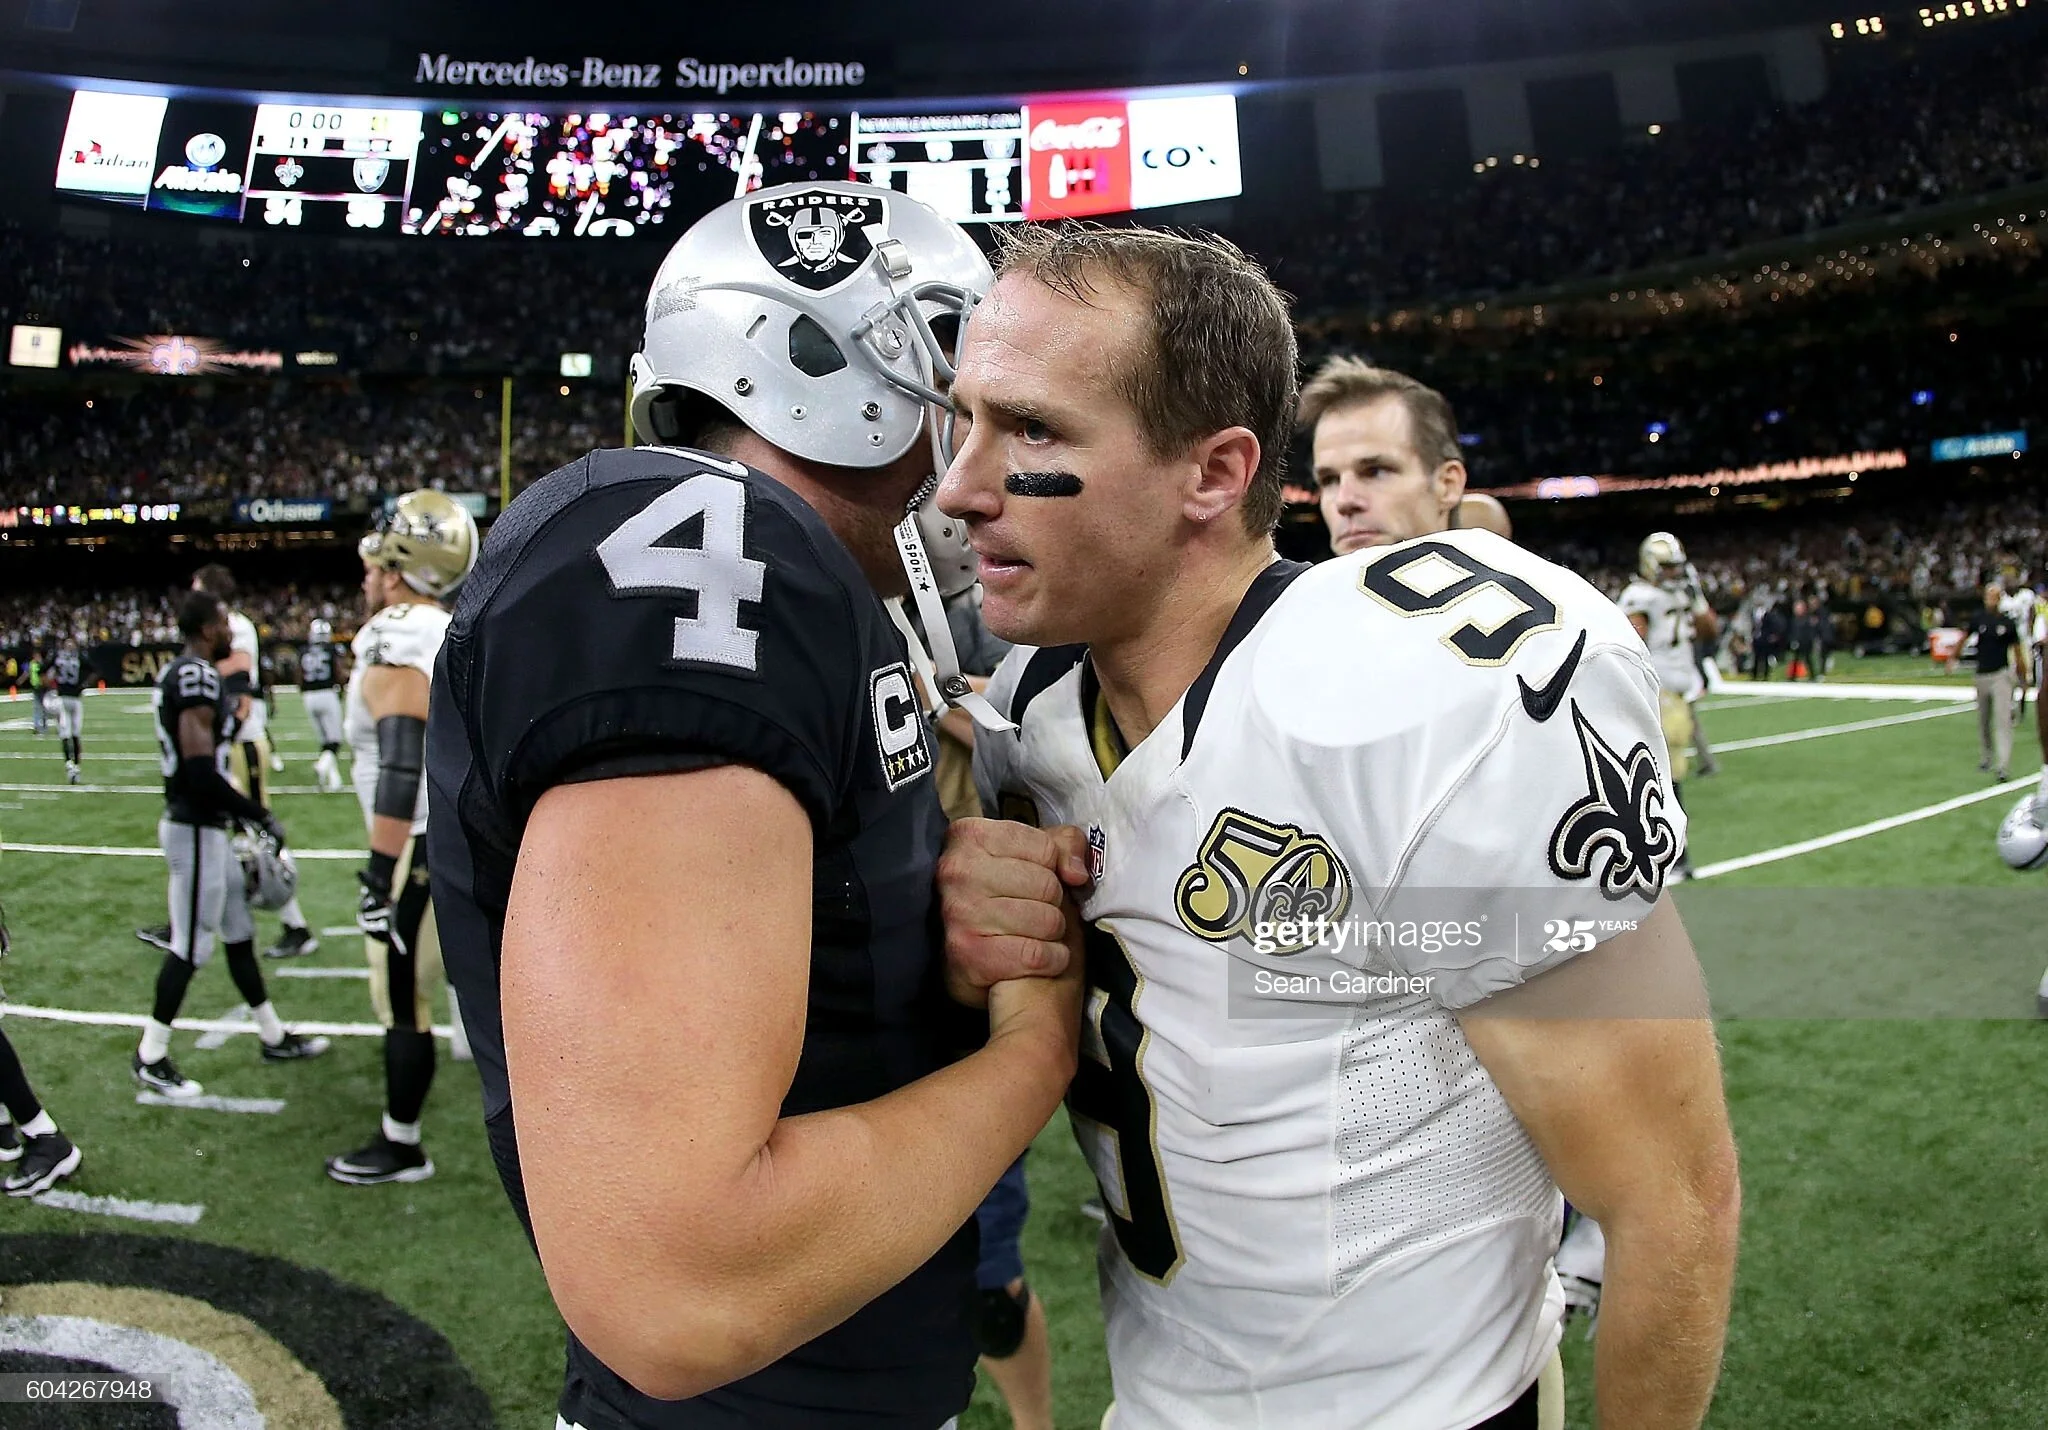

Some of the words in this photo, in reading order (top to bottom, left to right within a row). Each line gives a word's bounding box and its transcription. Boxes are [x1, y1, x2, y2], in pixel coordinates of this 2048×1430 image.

[415, 53, 661, 89] Mercedes-Benz
[676, 57, 866, 95] Superdome
[763, 195, 870, 211] RAIDERS
[596, 473, 766, 672] 4
[1356, 538, 1565, 668] 9
[178, 662, 220, 700] 25
[874, 671, 920, 756] C
